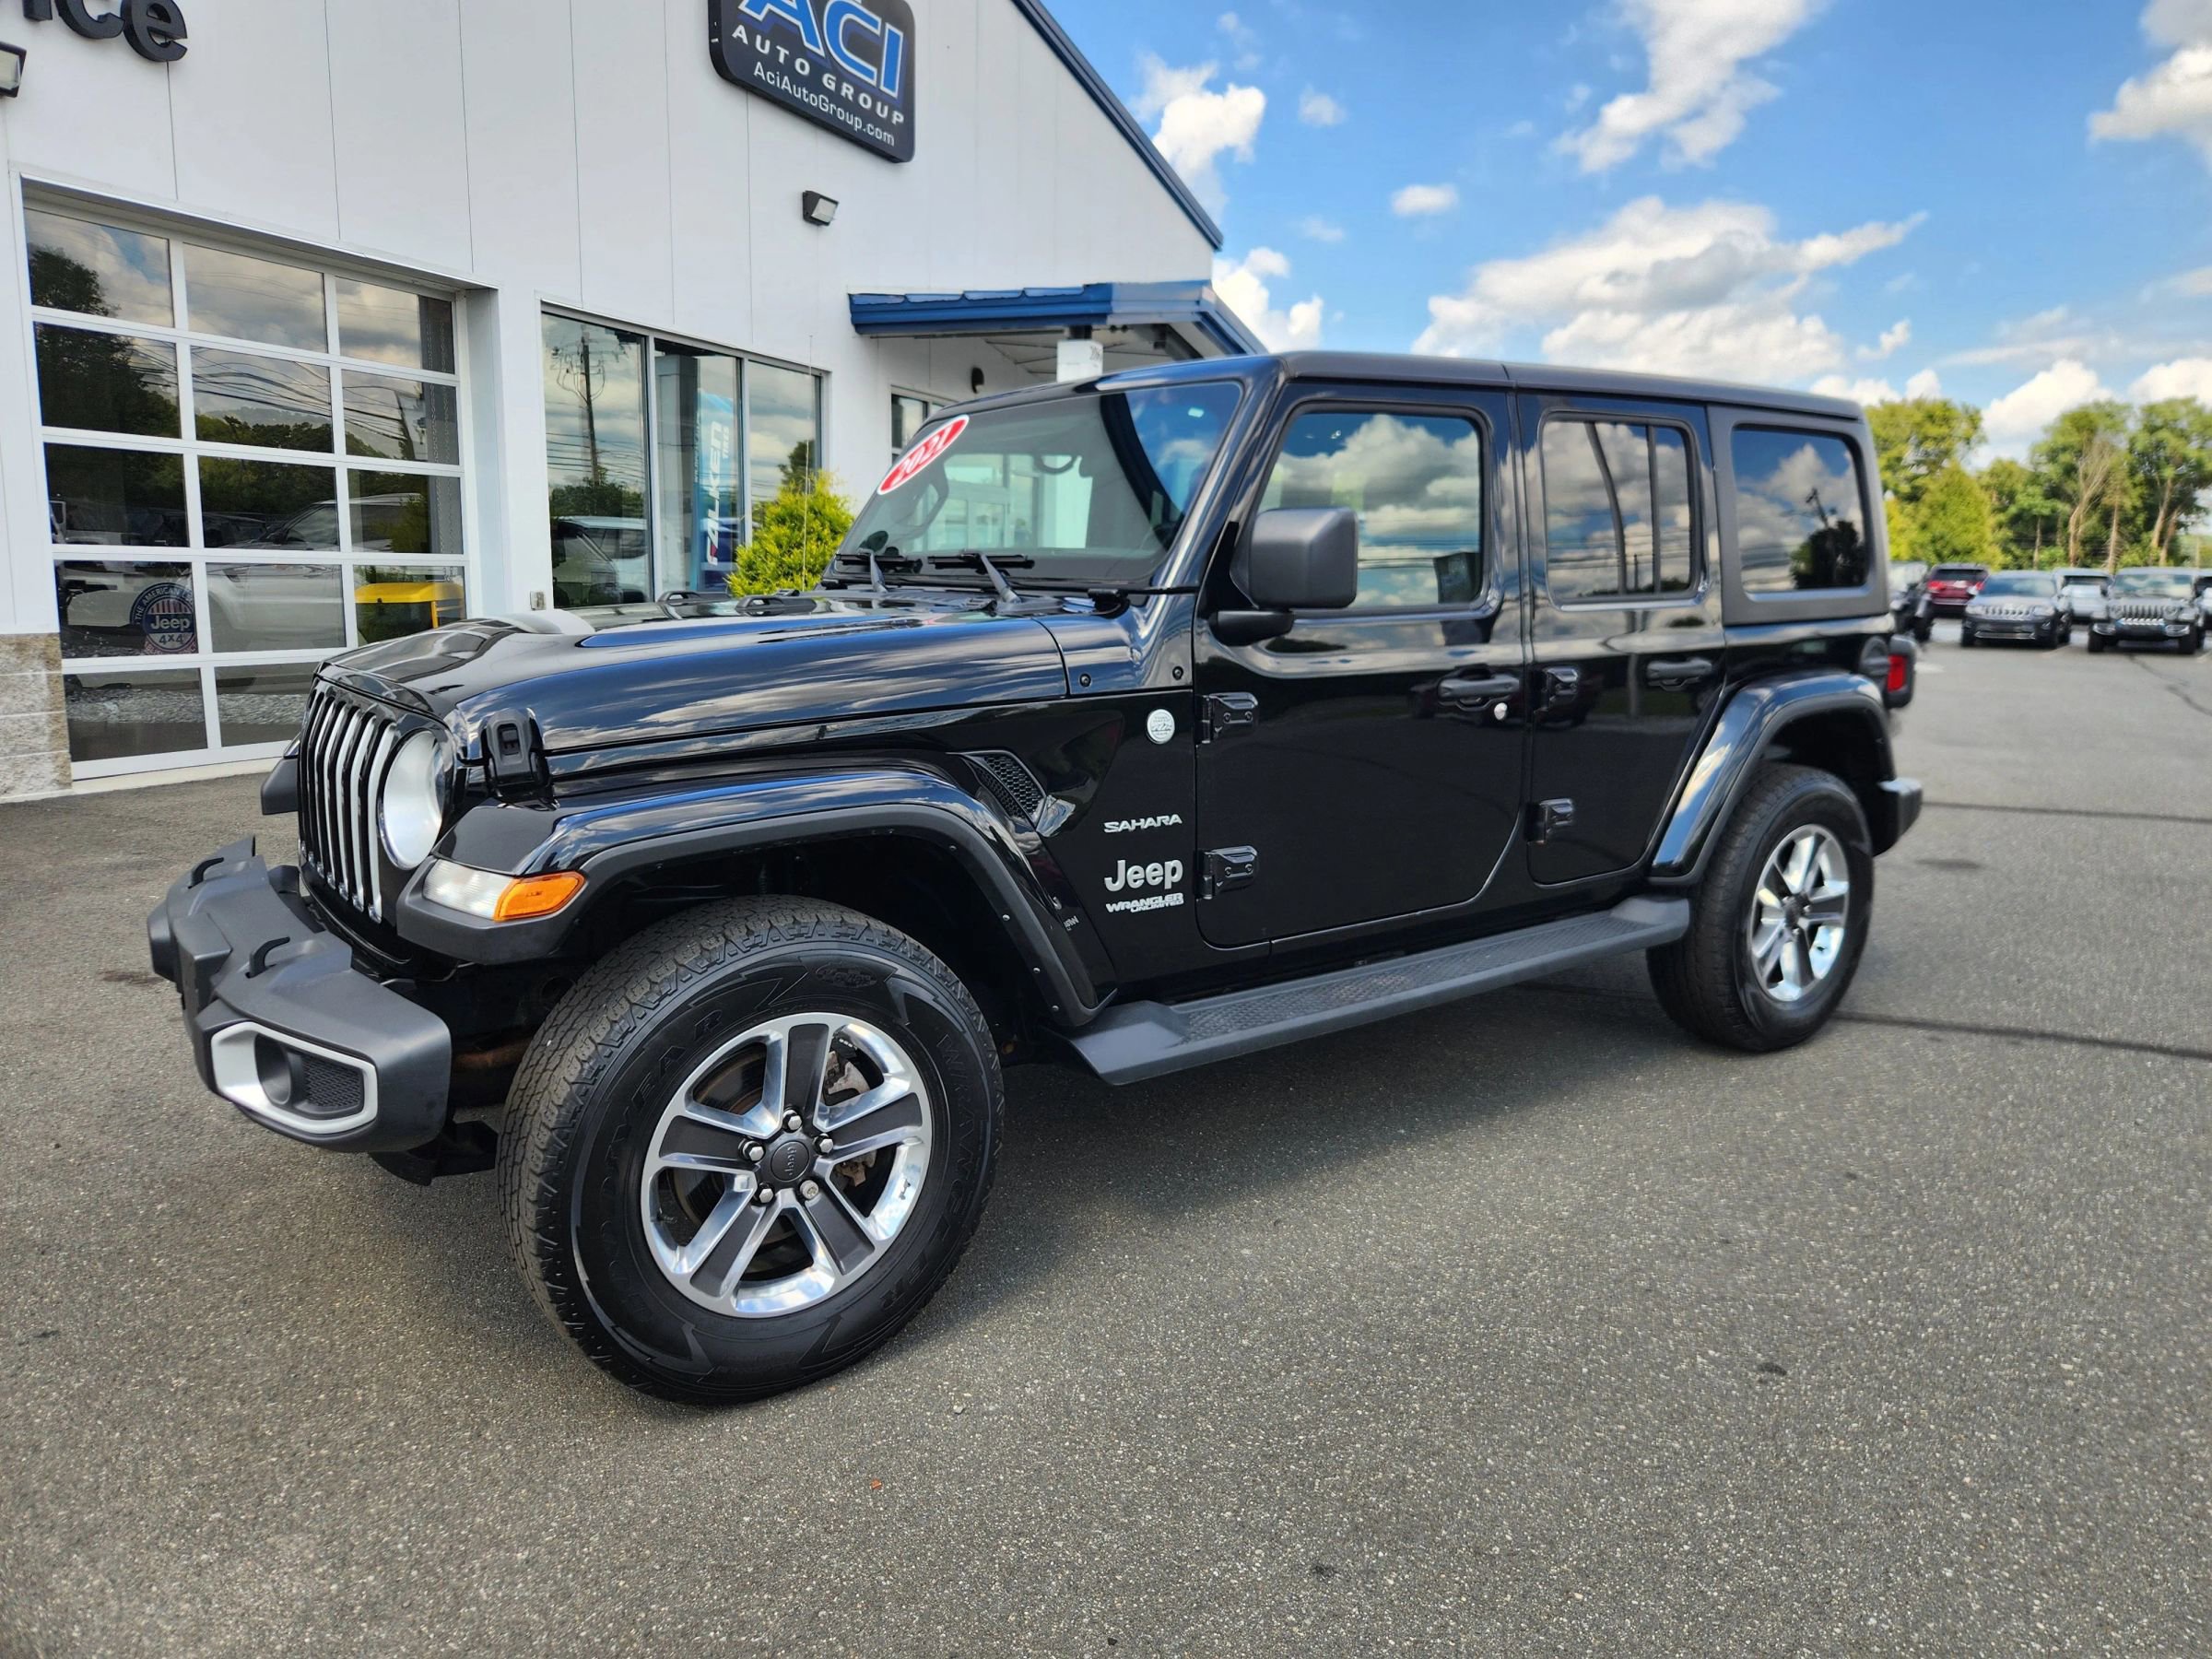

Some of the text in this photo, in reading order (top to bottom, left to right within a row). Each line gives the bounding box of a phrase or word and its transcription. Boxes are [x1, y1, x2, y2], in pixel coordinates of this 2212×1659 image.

[738, 0, 903, 100] ACI
[732, 24, 904, 125] AUTO GROUP
[753, 61, 895, 147] AciAutoGroup.com
[135, 605, 145, 621] THE
[142, 586, 180, 606] AMERICAN
[150, 615, 190, 631] Jeep
[1104, 814, 1182, 833] SAHARA
[1104, 859, 1183, 892] Jeep
[1106, 892, 1183, 912] WRANGLER
